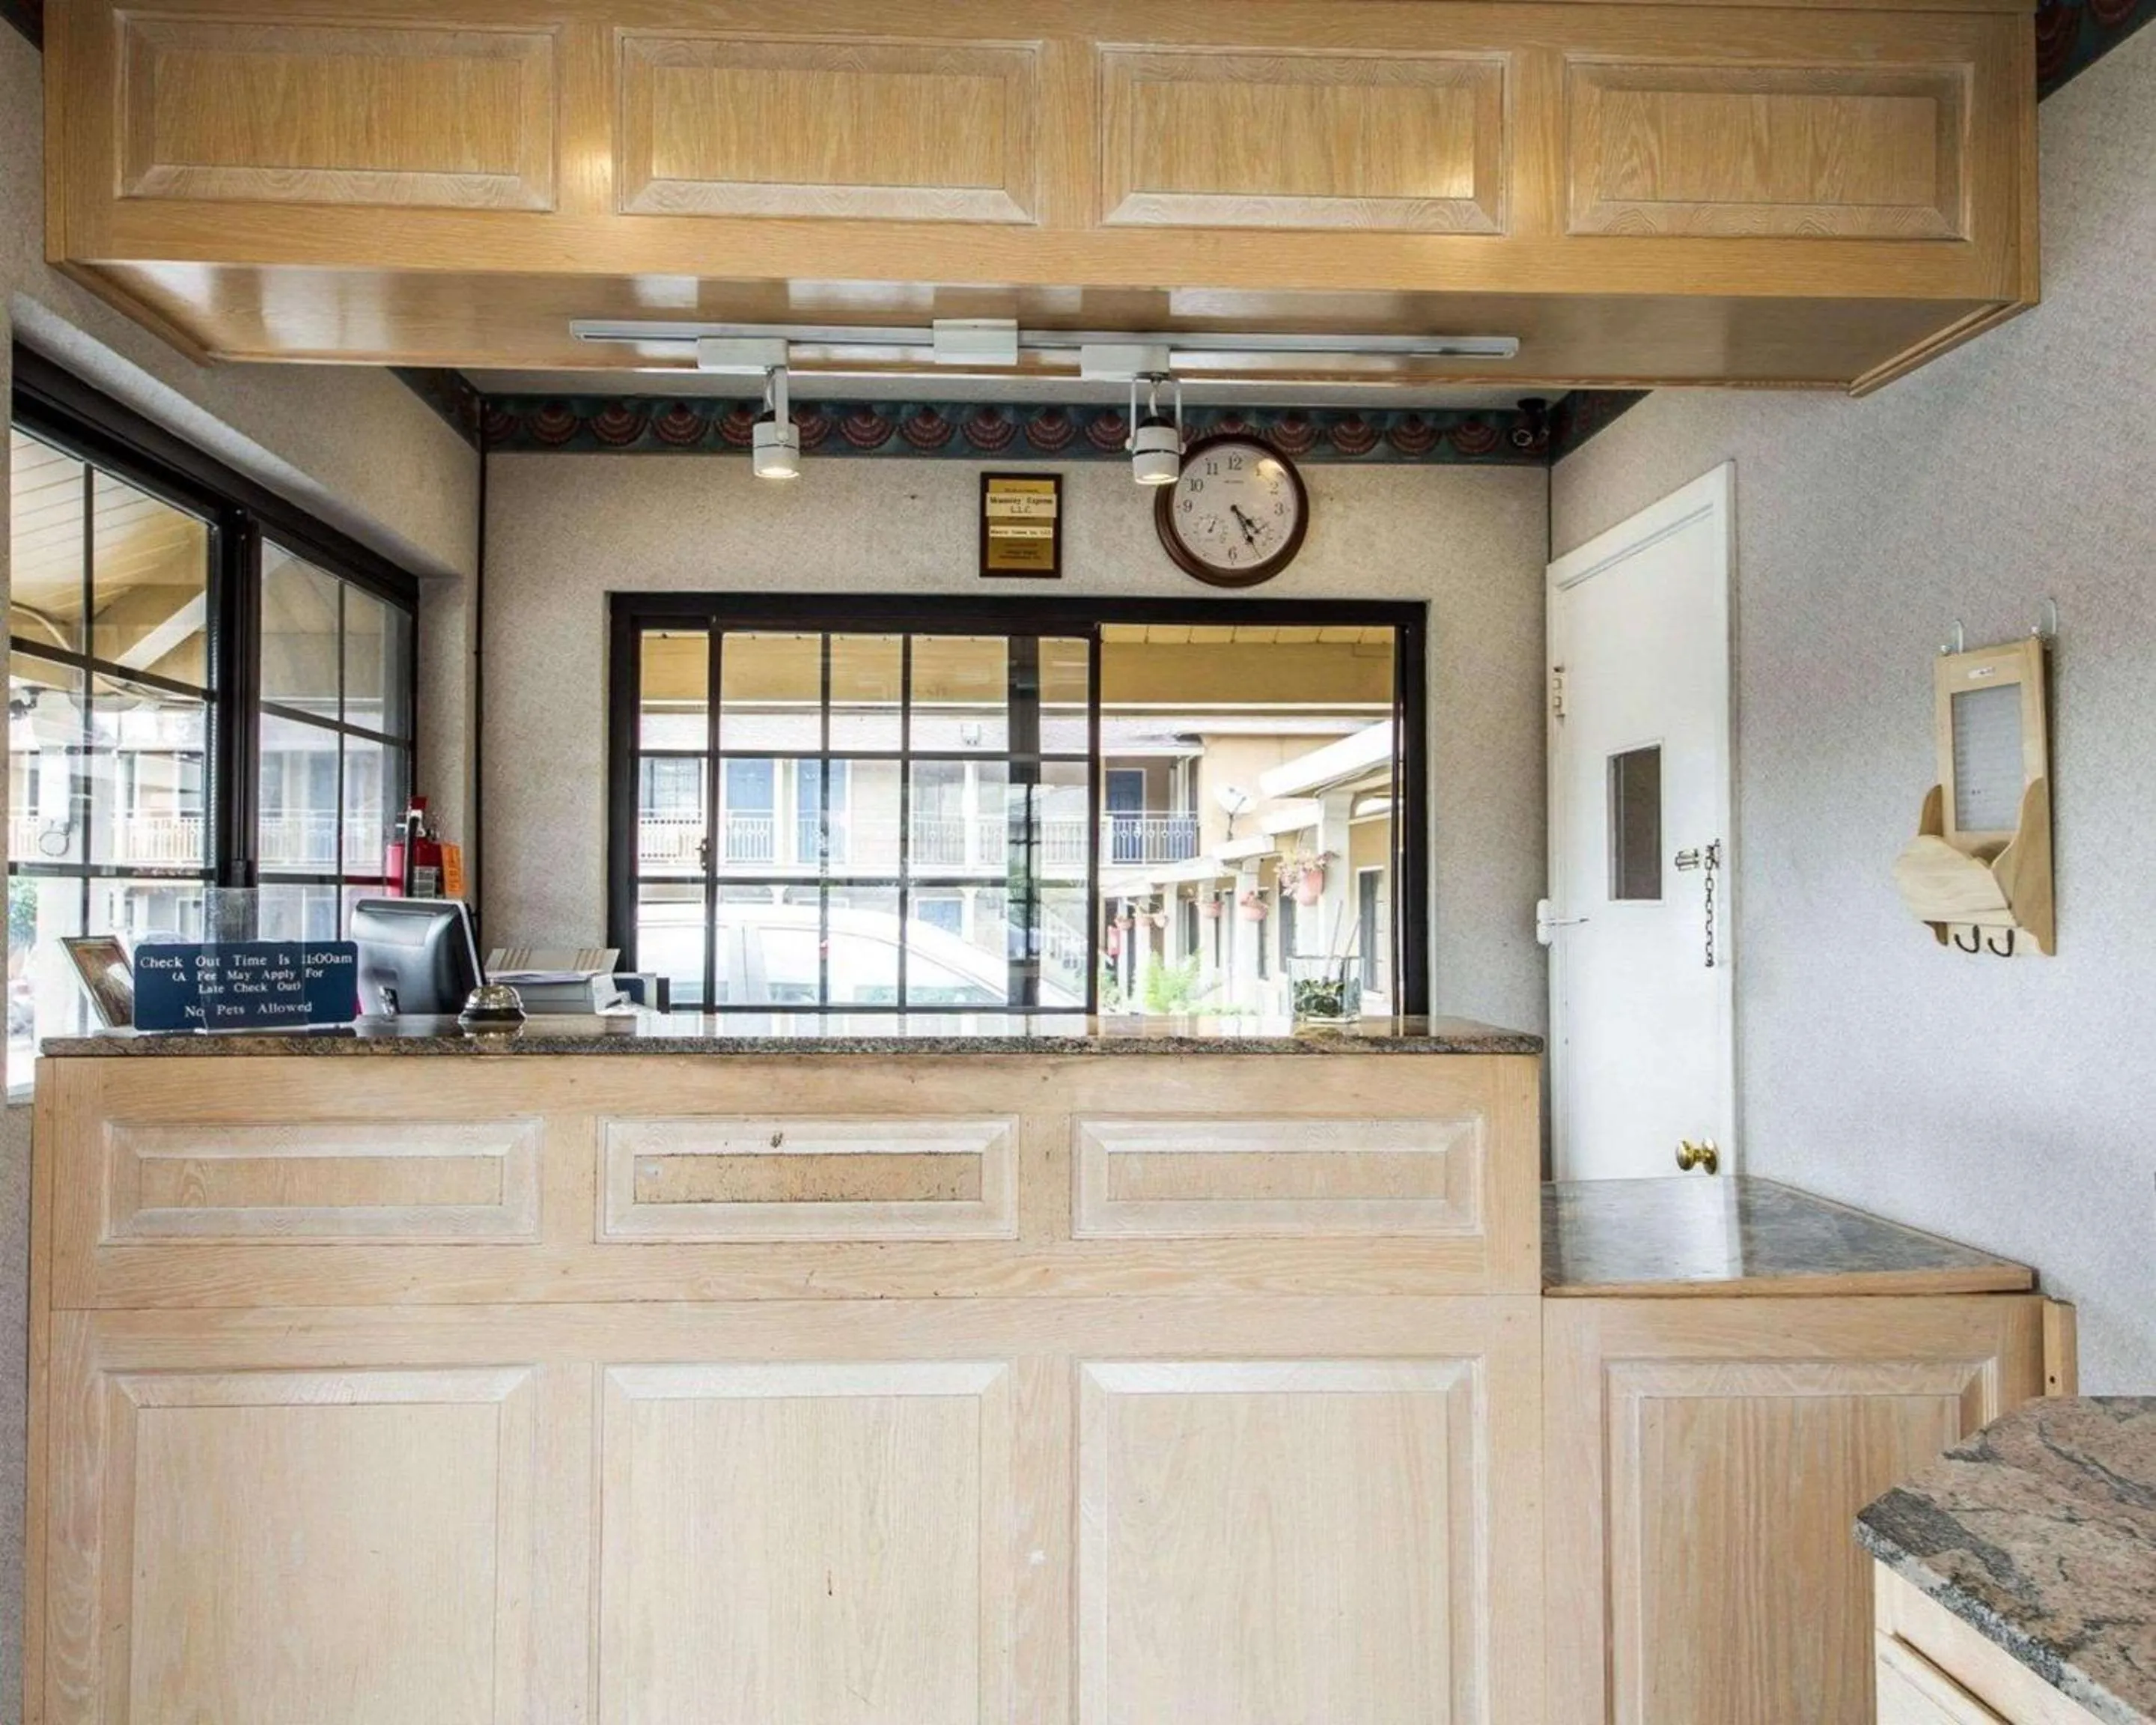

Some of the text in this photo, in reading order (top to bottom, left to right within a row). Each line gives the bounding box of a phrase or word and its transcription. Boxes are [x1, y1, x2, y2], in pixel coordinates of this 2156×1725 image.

[1206, 462, 1219, 475] 11
[1228, 456, 1242, 471] 12
[1190, 478, 1204, 492] 10
[1270, 481, 1279, 495] 2
[1182, 499, 1193, 514] 9
[1274, 502, 1284, 516] 3
[1227, 547, 1237, 560] 6
[140, 956, 183, 968] Check
[195, 955, 220, 967] Out
[233, 954, 267, 967] Time
[278, 954, 290, 965] Is
[197, 970, 217, 981] Fee
[227, 970, 251, 981] May
[262, 969, 296, 981] Apply
[305, 967, 324, 978] For
[198, 984, 225, 994] Late
[234, 982, 268, 993] Check
[184, 1002, 312, 1017] No Pets Allowed
